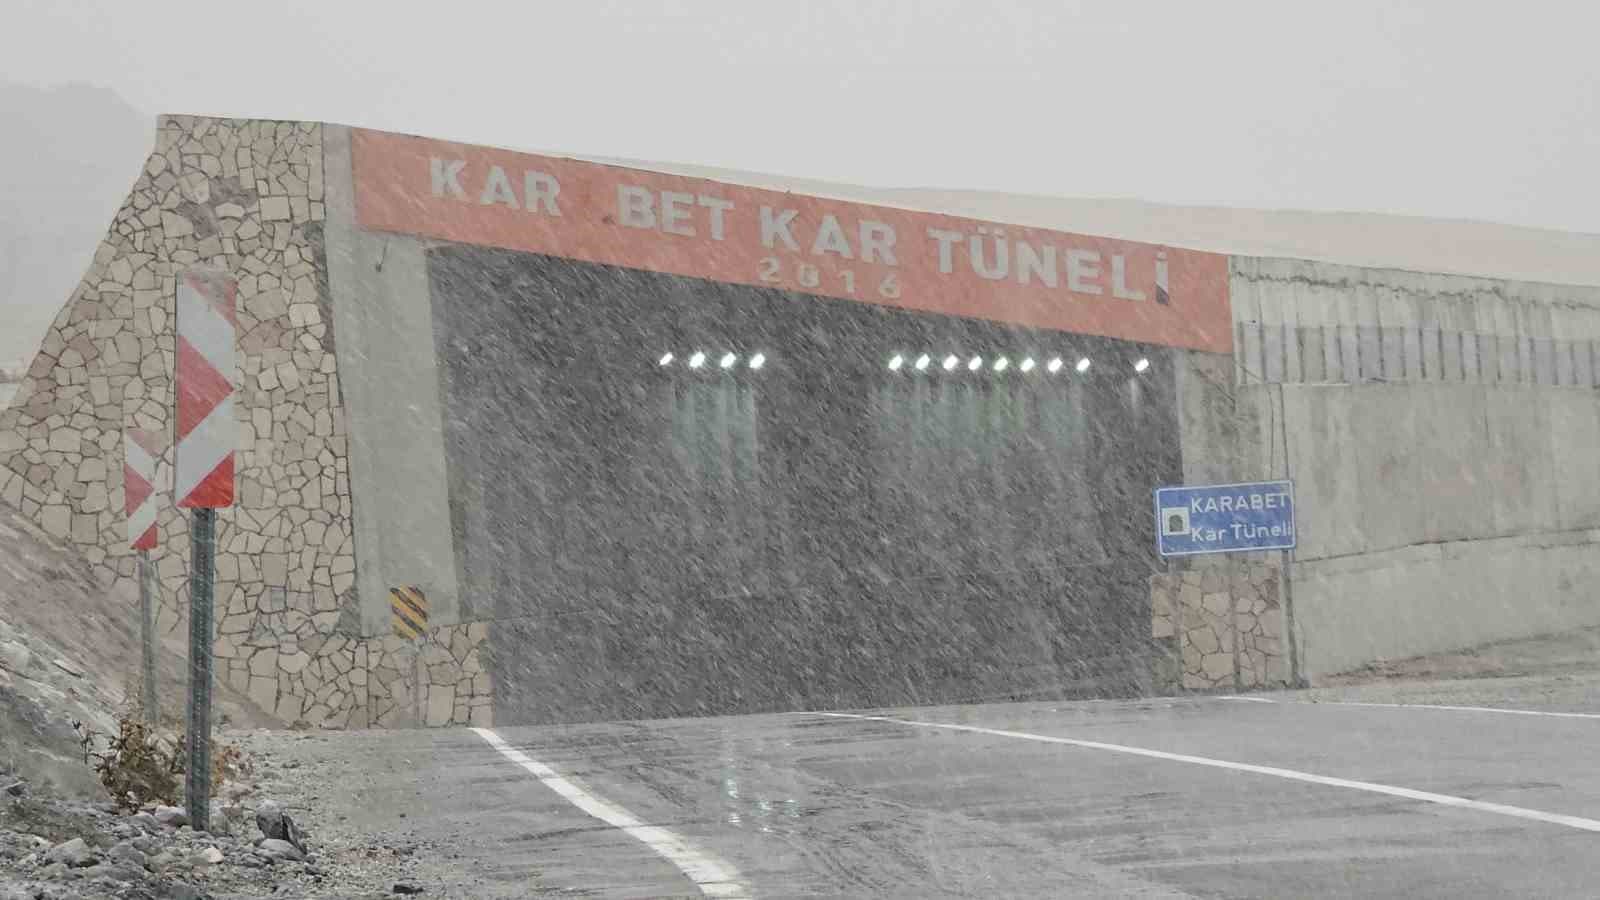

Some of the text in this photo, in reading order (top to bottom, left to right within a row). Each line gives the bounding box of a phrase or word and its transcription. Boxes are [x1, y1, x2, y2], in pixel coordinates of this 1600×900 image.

[429, 158, 1170, 306] KAR BET KAR TÜNELİ
[1191, 493, 1289, 513] KARABET
[1191, 520, 1292, 542] Kar Tüneli
